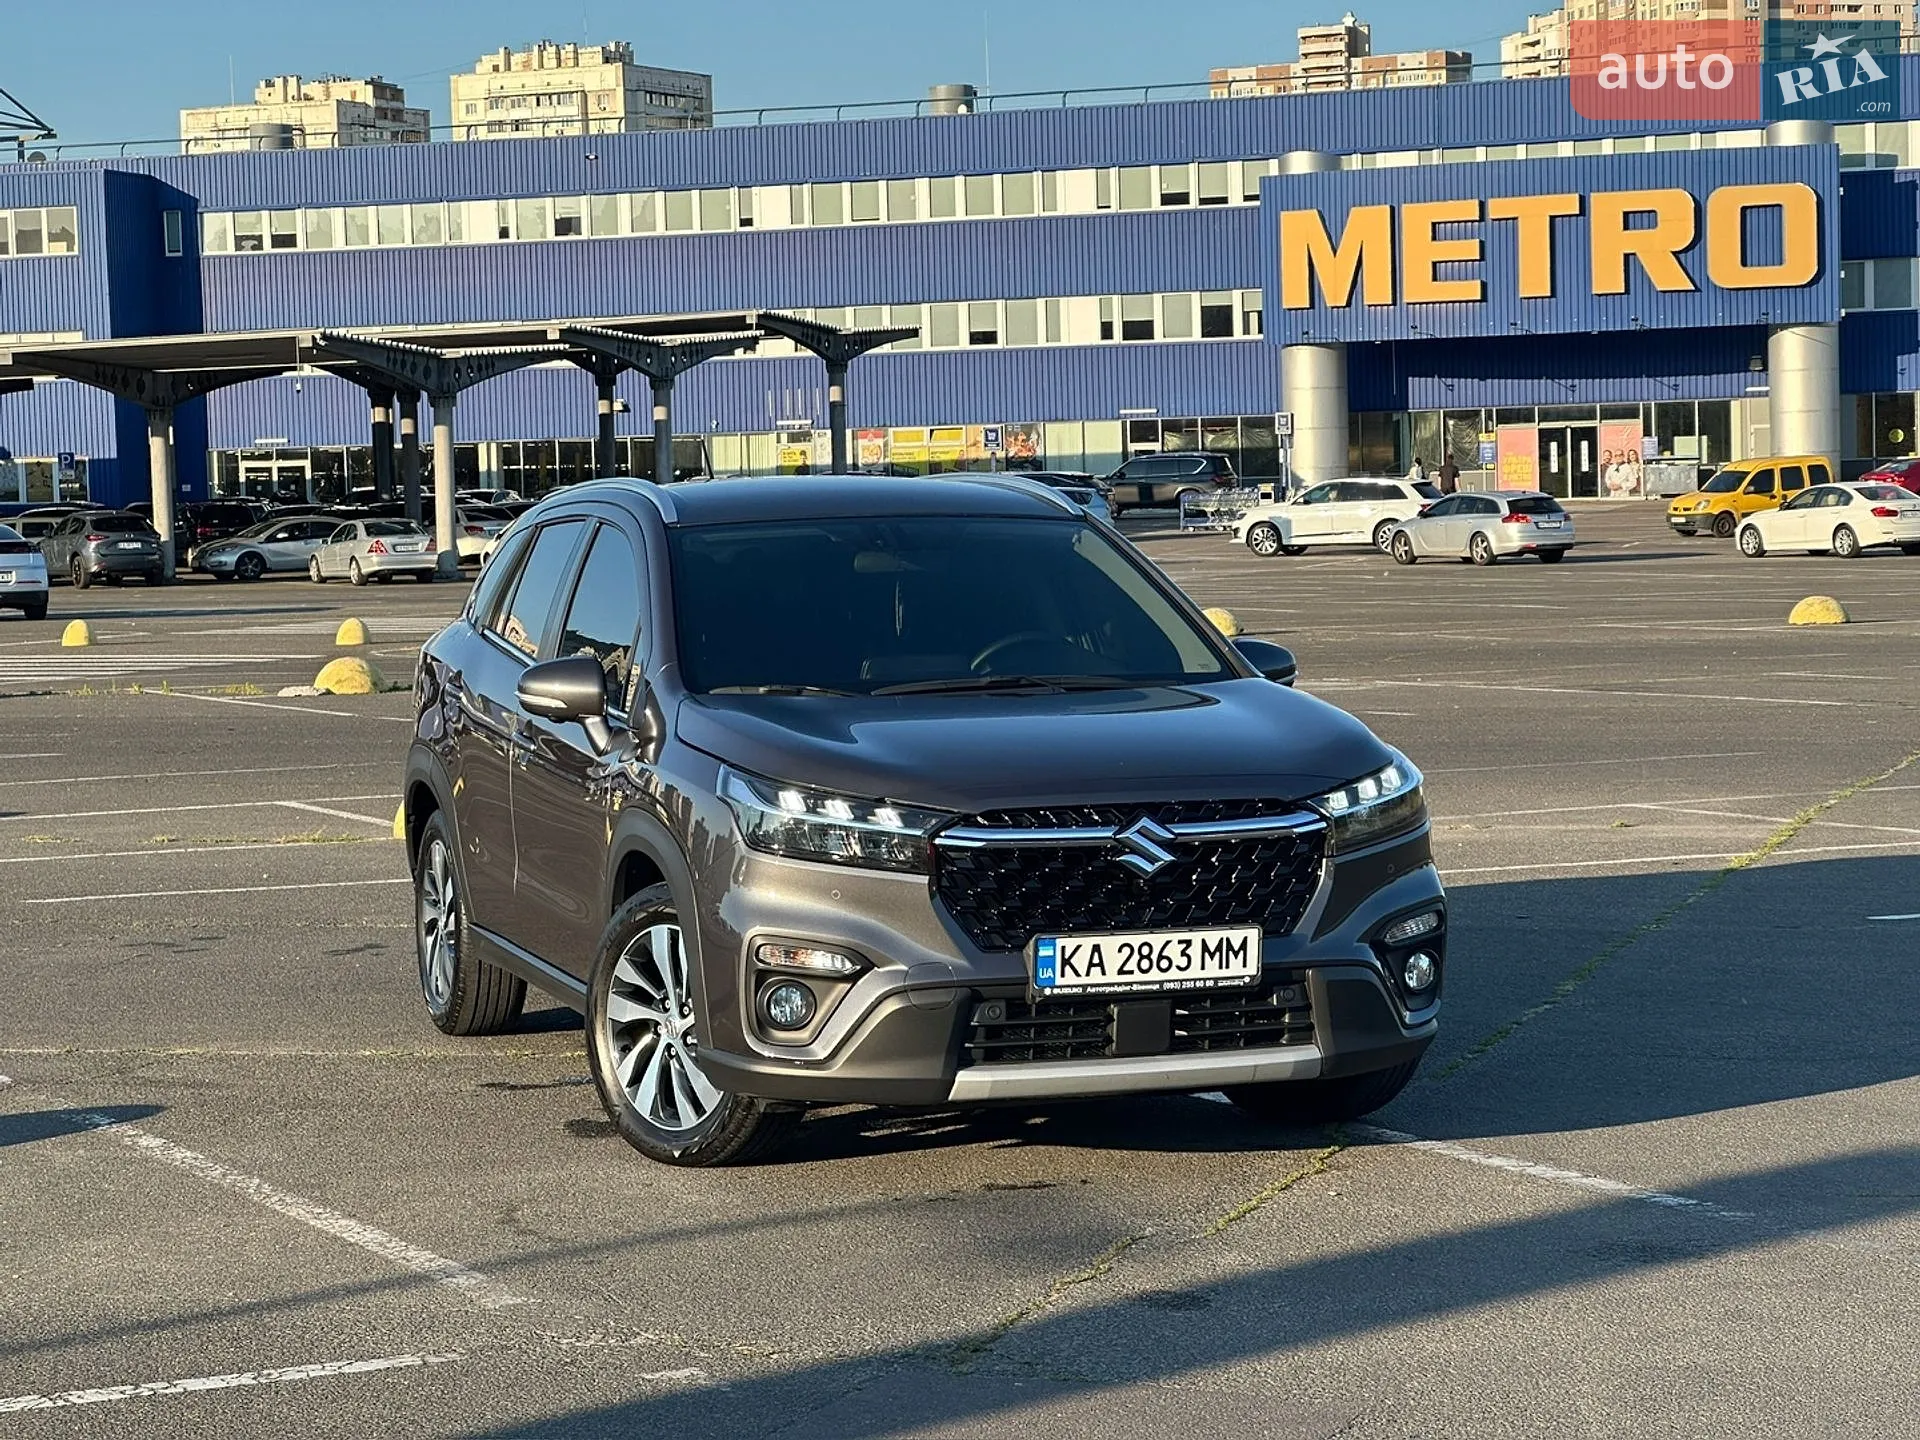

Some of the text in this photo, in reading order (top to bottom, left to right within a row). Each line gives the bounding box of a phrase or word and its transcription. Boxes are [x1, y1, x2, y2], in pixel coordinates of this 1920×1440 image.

[1280, 182, 1819, 311] METRO
[61, 454, 71, 469] P
[1060, 936, 1248, 979] KA 2863 MM
[1038, 967, 1054, 979] UA
